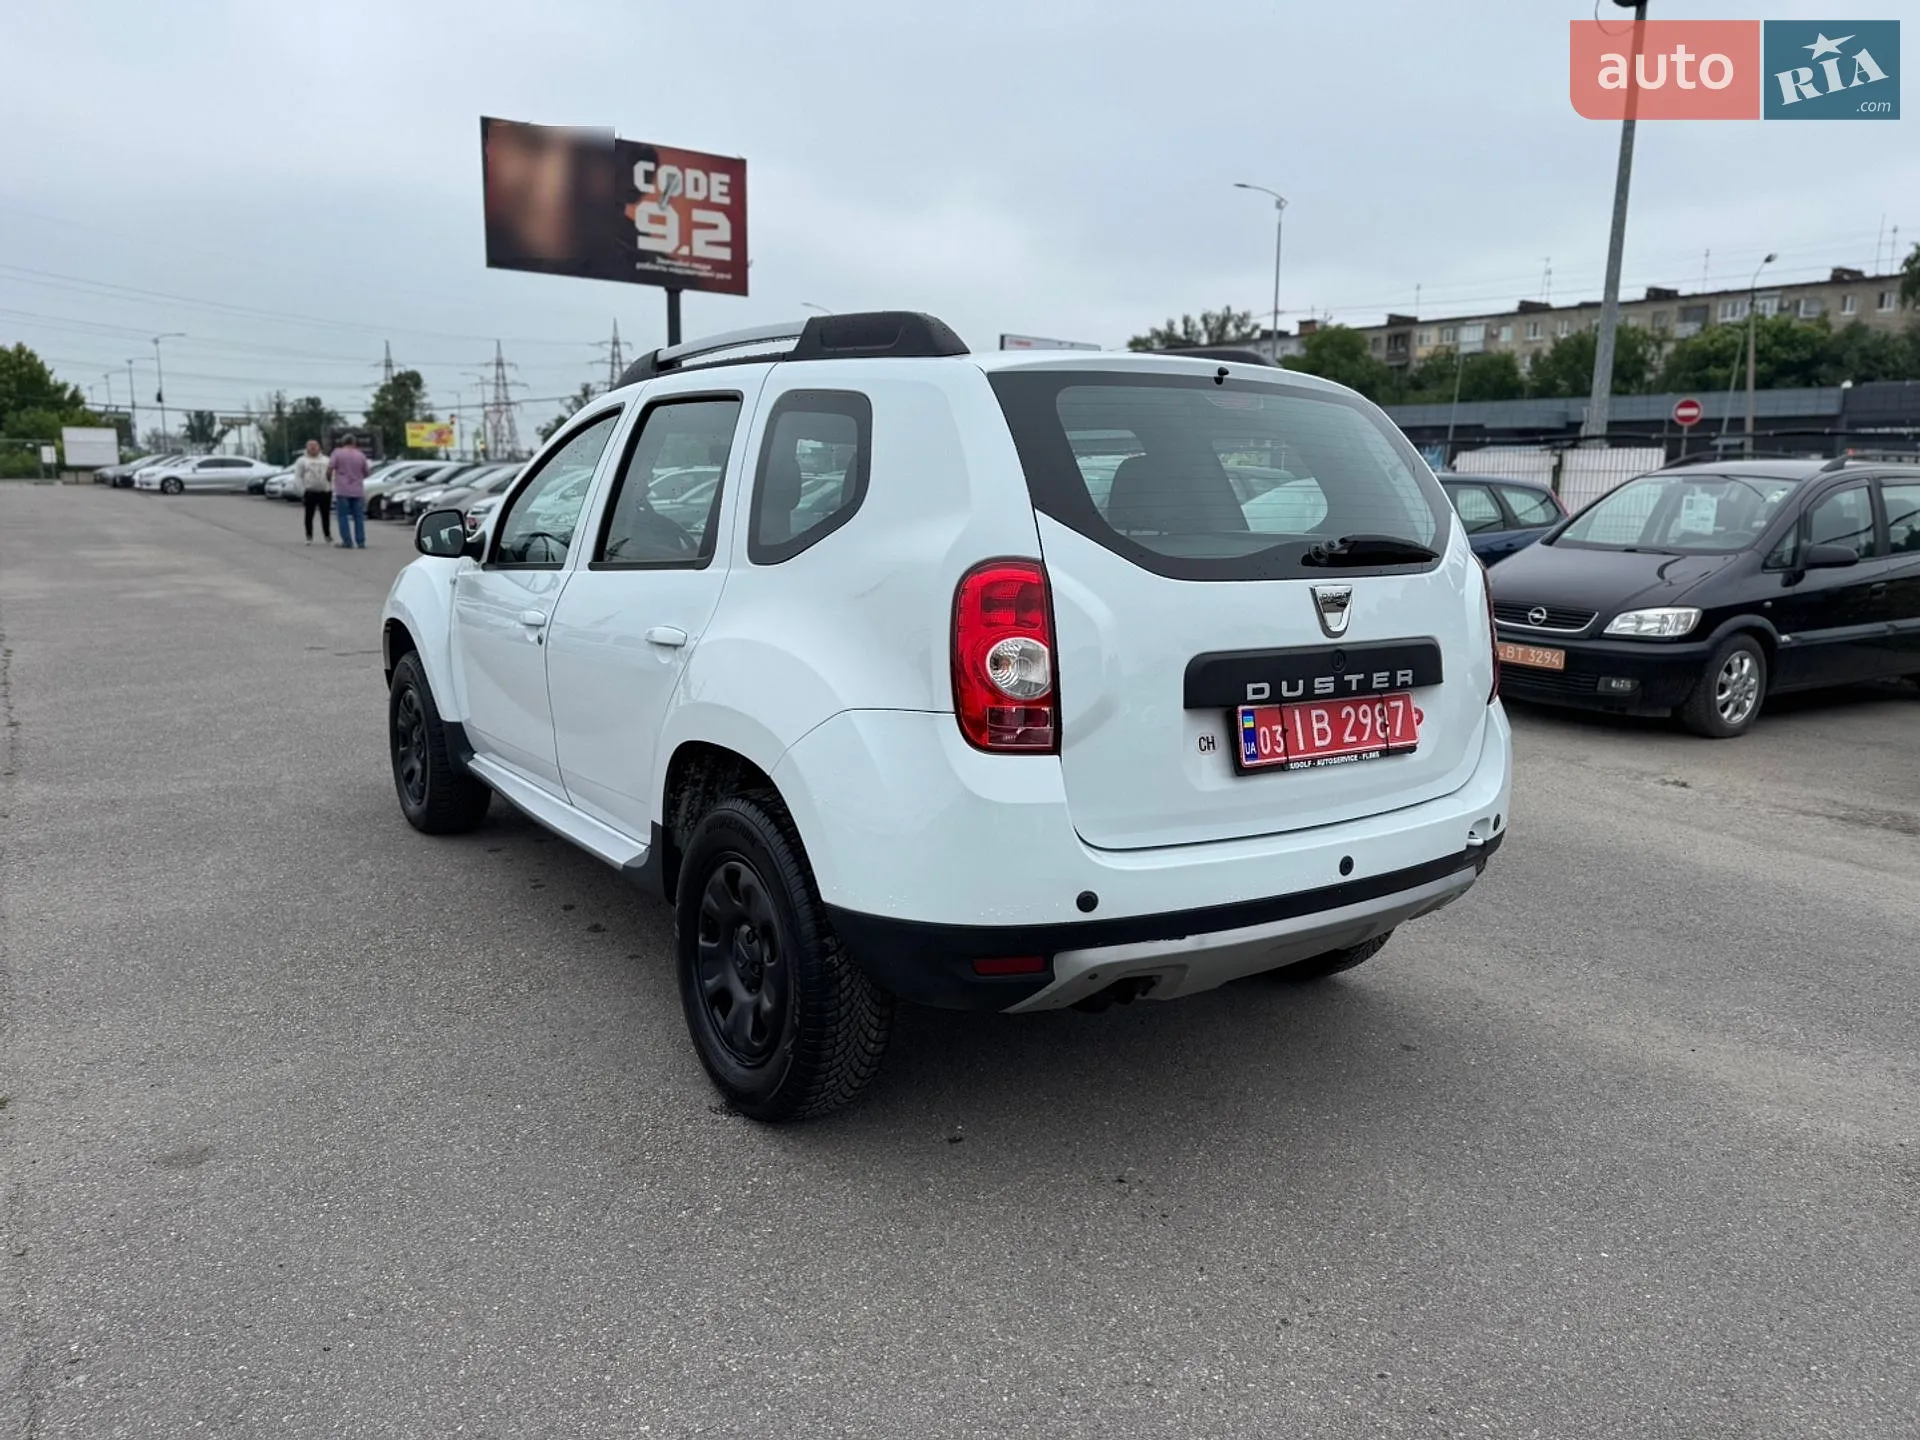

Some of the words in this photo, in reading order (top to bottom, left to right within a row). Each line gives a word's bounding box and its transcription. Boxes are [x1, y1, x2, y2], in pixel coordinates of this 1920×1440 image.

[633, 160, 731, 205] CODE
[634, 200, 732, 261] 9.2
[1528, 648, 1561, 666] 3294
[1246, 669, 1413, 701] DUSTER
[1198, 735, 1216, 752] CH
[1259, 724, 1285, 755] 03
[1341, 700, 1404, 743] 2987
[1244, 741, 1257, 755] UA
